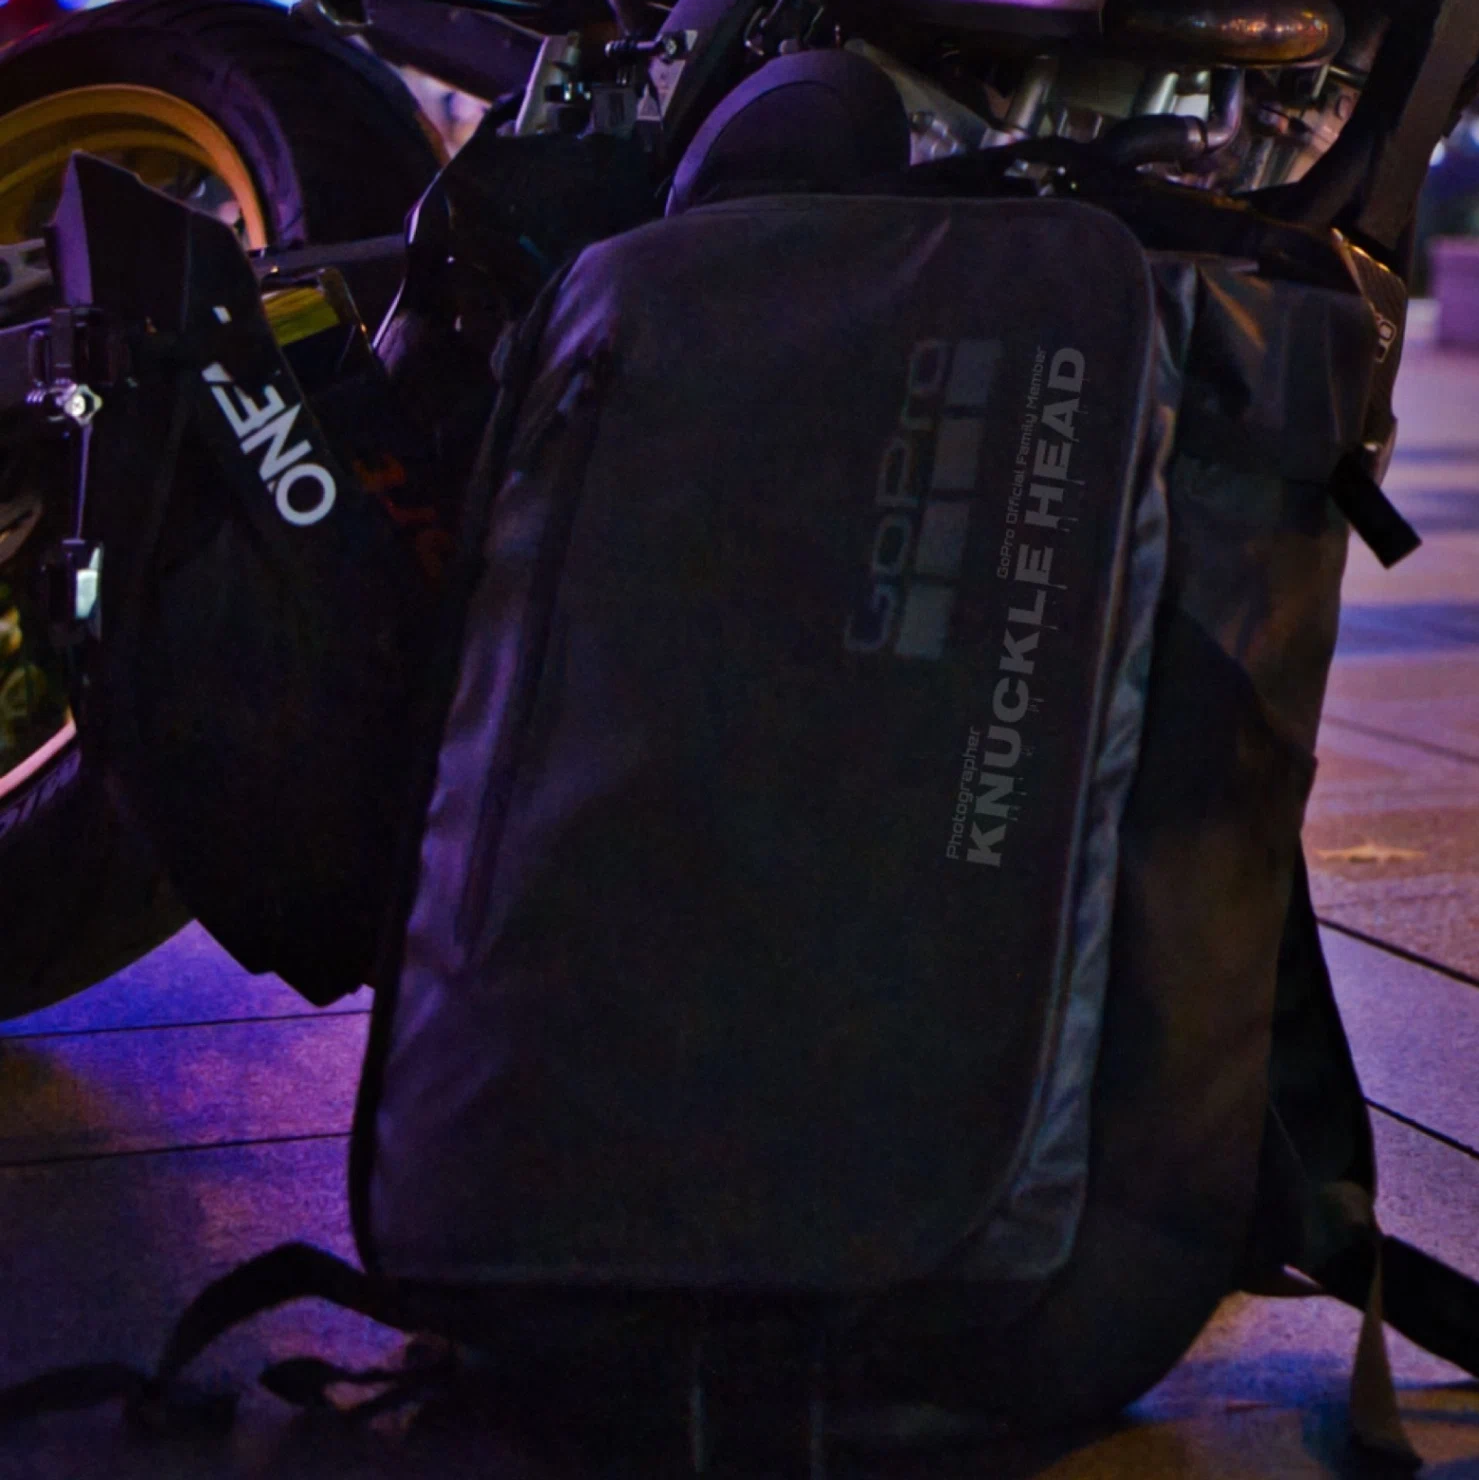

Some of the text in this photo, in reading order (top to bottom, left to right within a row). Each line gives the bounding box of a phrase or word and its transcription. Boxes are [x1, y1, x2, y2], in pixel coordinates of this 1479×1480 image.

[844, 338, 948, 653] GoPro
[997, 344, 1047, 580] GoPro Official Family Member
[966, 347, 1087, 868] KNUCKLE HEAD
[945, 724, 981, 860] Photographer
